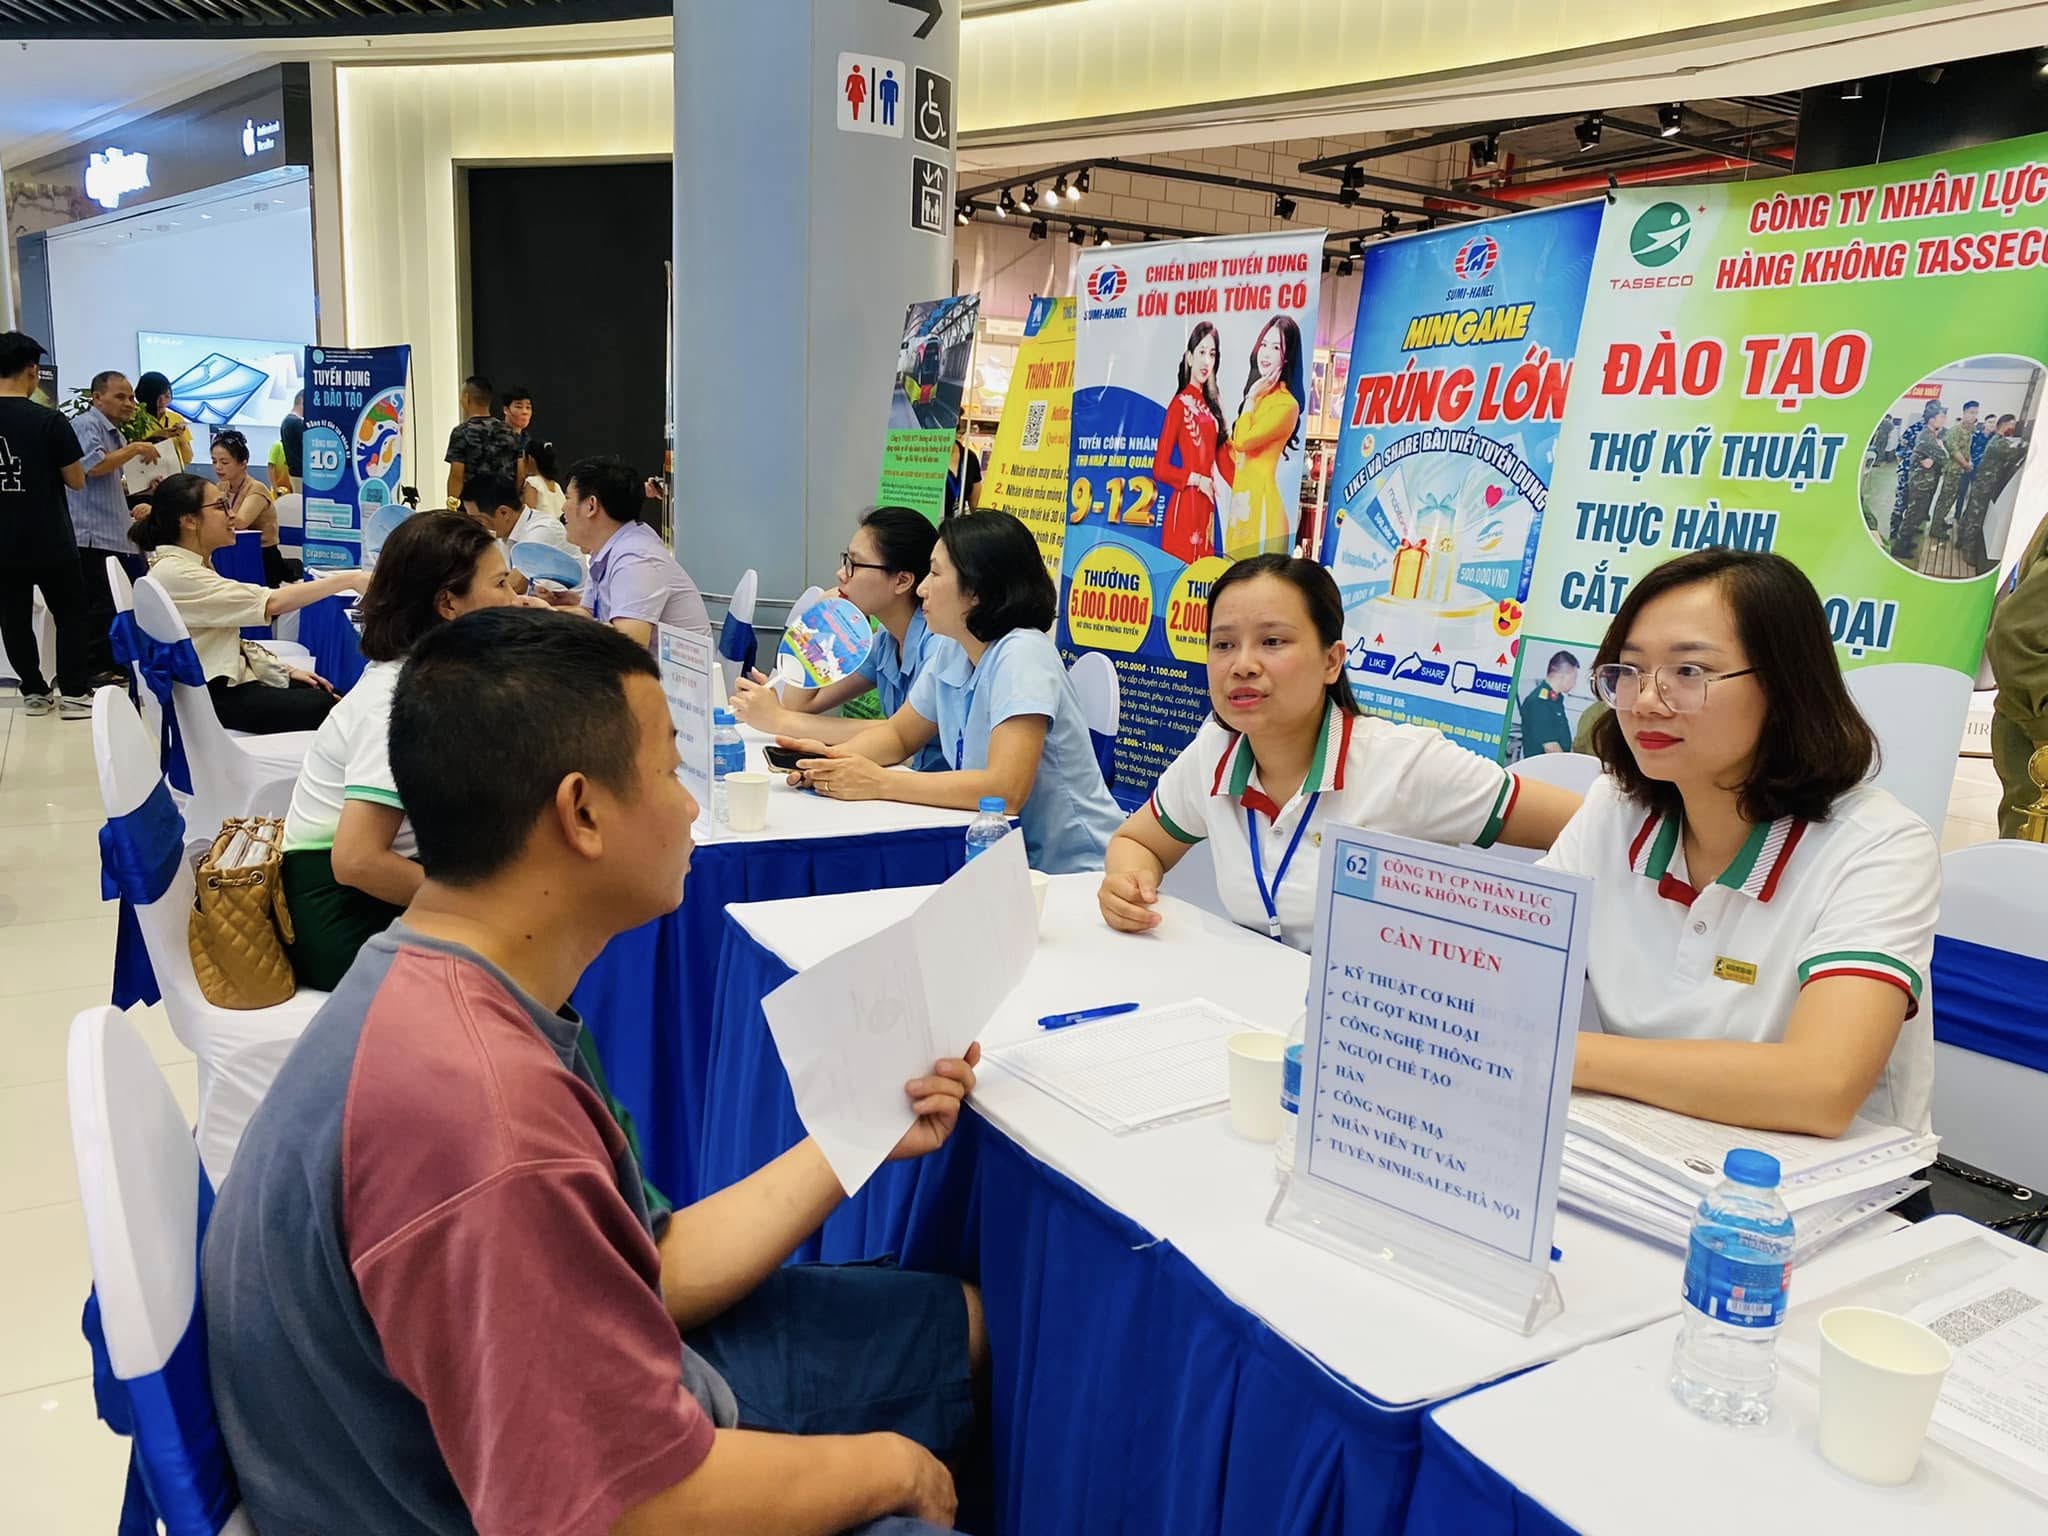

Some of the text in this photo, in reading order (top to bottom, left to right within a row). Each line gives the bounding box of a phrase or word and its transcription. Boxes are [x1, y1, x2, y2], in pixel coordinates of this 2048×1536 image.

[1750, 164, 2048, 233] CÔNG TY NHÂN LỰC
[1146, 258, 1184, 282] CHIẾN
[1188, 261, 1217, 284] DỊCH
[1267, 253, 1308, 276] DỤNG
[1610, 275, 1694, 290] TASSECO
[1715, 251, 1794, 289] HÀNG
[1801, 240, 1906, 284] KHÔNG
[1084, 307, 1128, 320] SUMI-HANEL
[1137, 279, 1307, 317] LỚN CHƯA TỪNG CÓ
[1446, 284, 1495, 301] SUMI-HANEL
[1403, 304, 1534, 351] MINIGAME
[345, 370, 371, 390] DỤNG
[1352, 345, 1573, 426] TRÚNG LỚN
[1602, 331, 1868, 408] ĐÀO TẠO
[313, 388, 363, 411] & ĐÀO TẠO
[310, 450, 339, 471] 10
[1103, 435, 1126, 450] CÔNG
[1129, 436, 1158, 451] NHÂN
[1590, 427, 1845, 490] THỢ KỸ THUẬT
[1344, 470, 1367, 503] LIKE
[1367, 453, 1383, 475] VÀ
[1384, 434, 1421, 466] SHARE
[1421, 428, 1449, 451] BÀI
[1451, 427, 1477, 456] VIẾT
[1511, 461, 1548, 511] DỤNG
[1071, 476, 1158, 526] 9-12
[1576, 501, 1777, 553] THỰC HÀNH
[1084, 566, 1140, 591] THƯỞNG
[1071, 589, 1149, 625] 5.000.000đ
[1560, 560, 1896, 656] CẮT OẠI
[1369, 657, 1387, 669] LIKE
[1421, 666, 1446, 680] SHARE
[1346, 854, 1368, 875] 62
[1384, 858, 1553, 909] CÔNG TY CP NHÂN LỰC
[1381, 875, 1552, 927] HÀNG KHÔNG TASSECO
[1344, 964, 1475, 1013] KỸ THUẬT CƠ KHÍ
[1373, 1000, 1405, 1019] GỌT
[1408, 1010, 1439, 1029] KIM
[1442, 1020, 1480, 1043] LOẠI
[1339, 1015, 1515, 1080] CÔNG NGHỆ THÔNG TIN
[1335, 1064, 1366, 1084] HÀN
[1420, 1066, 1452, 1088] TẠO
[1333, 1089, 1446, 1140] CÔNG NGHỆ MẠ
[1331, 1114, 1370, 1138] NHÂN
[1373, 1128, 1408, 1152] VIÊN
[1411, 1143, 1433, 1160] TƯ
